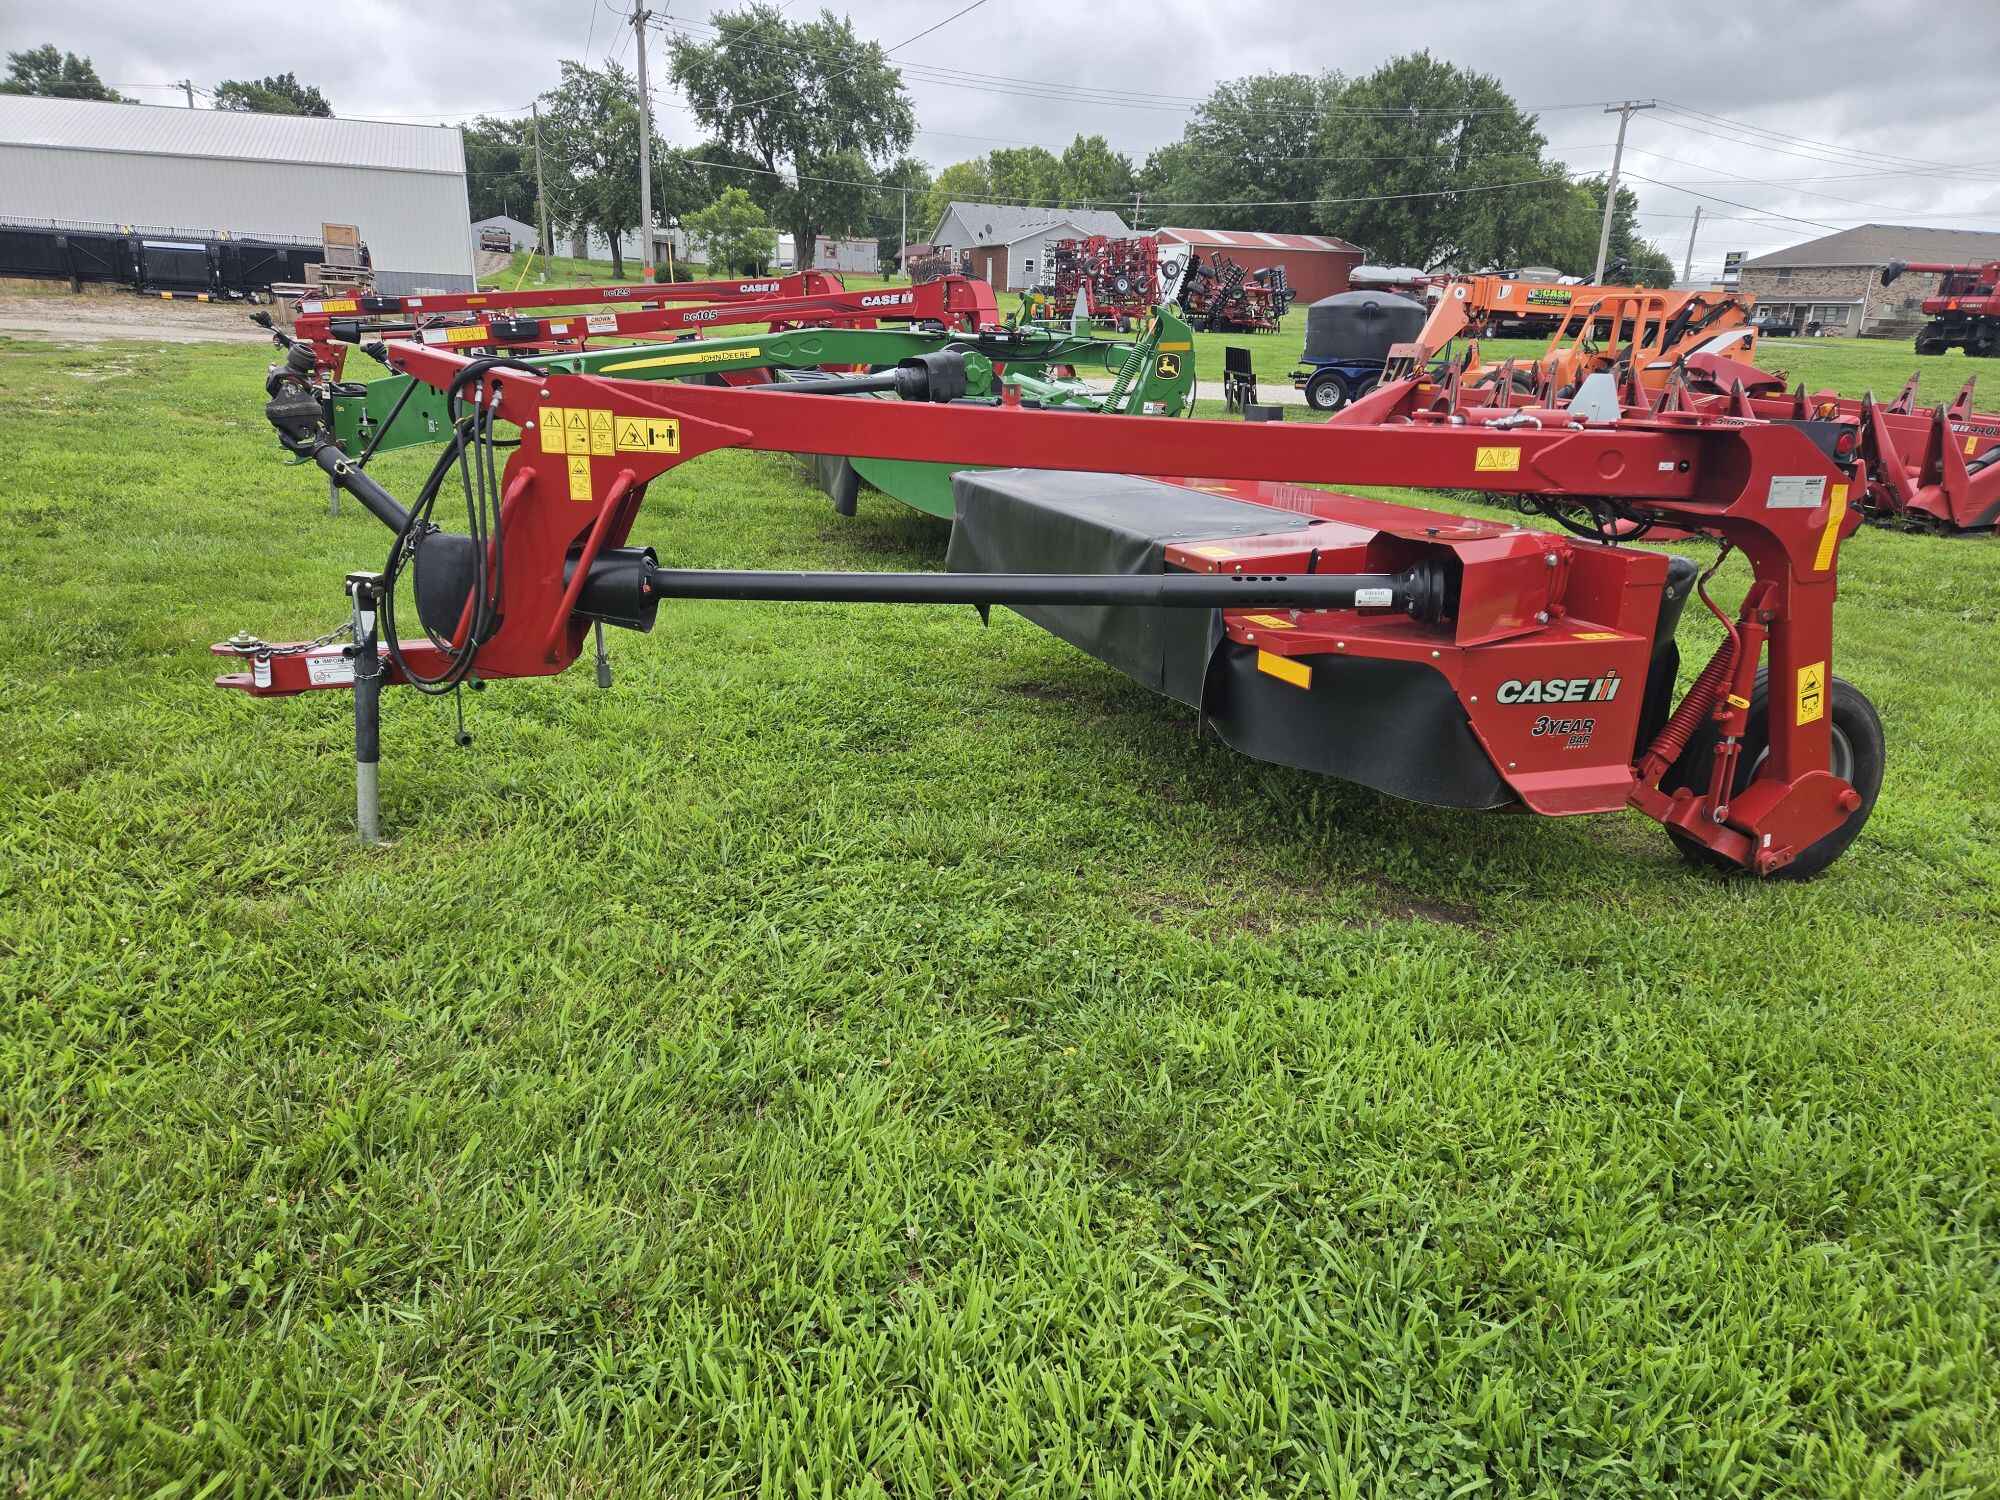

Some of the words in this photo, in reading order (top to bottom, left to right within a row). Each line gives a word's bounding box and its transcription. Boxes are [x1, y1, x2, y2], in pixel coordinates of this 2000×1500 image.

[740, 284, 769, 292] CASE
[862, 293, 900, 307] CASE
[684, 310, 718, 322] DC105
[699, 353, 722, 362] JOHN
[722, 350, 751, 360] DEERE
[1496, 679, 1589, 704] CASE
[1568, 735, 1591, 745] BAR
